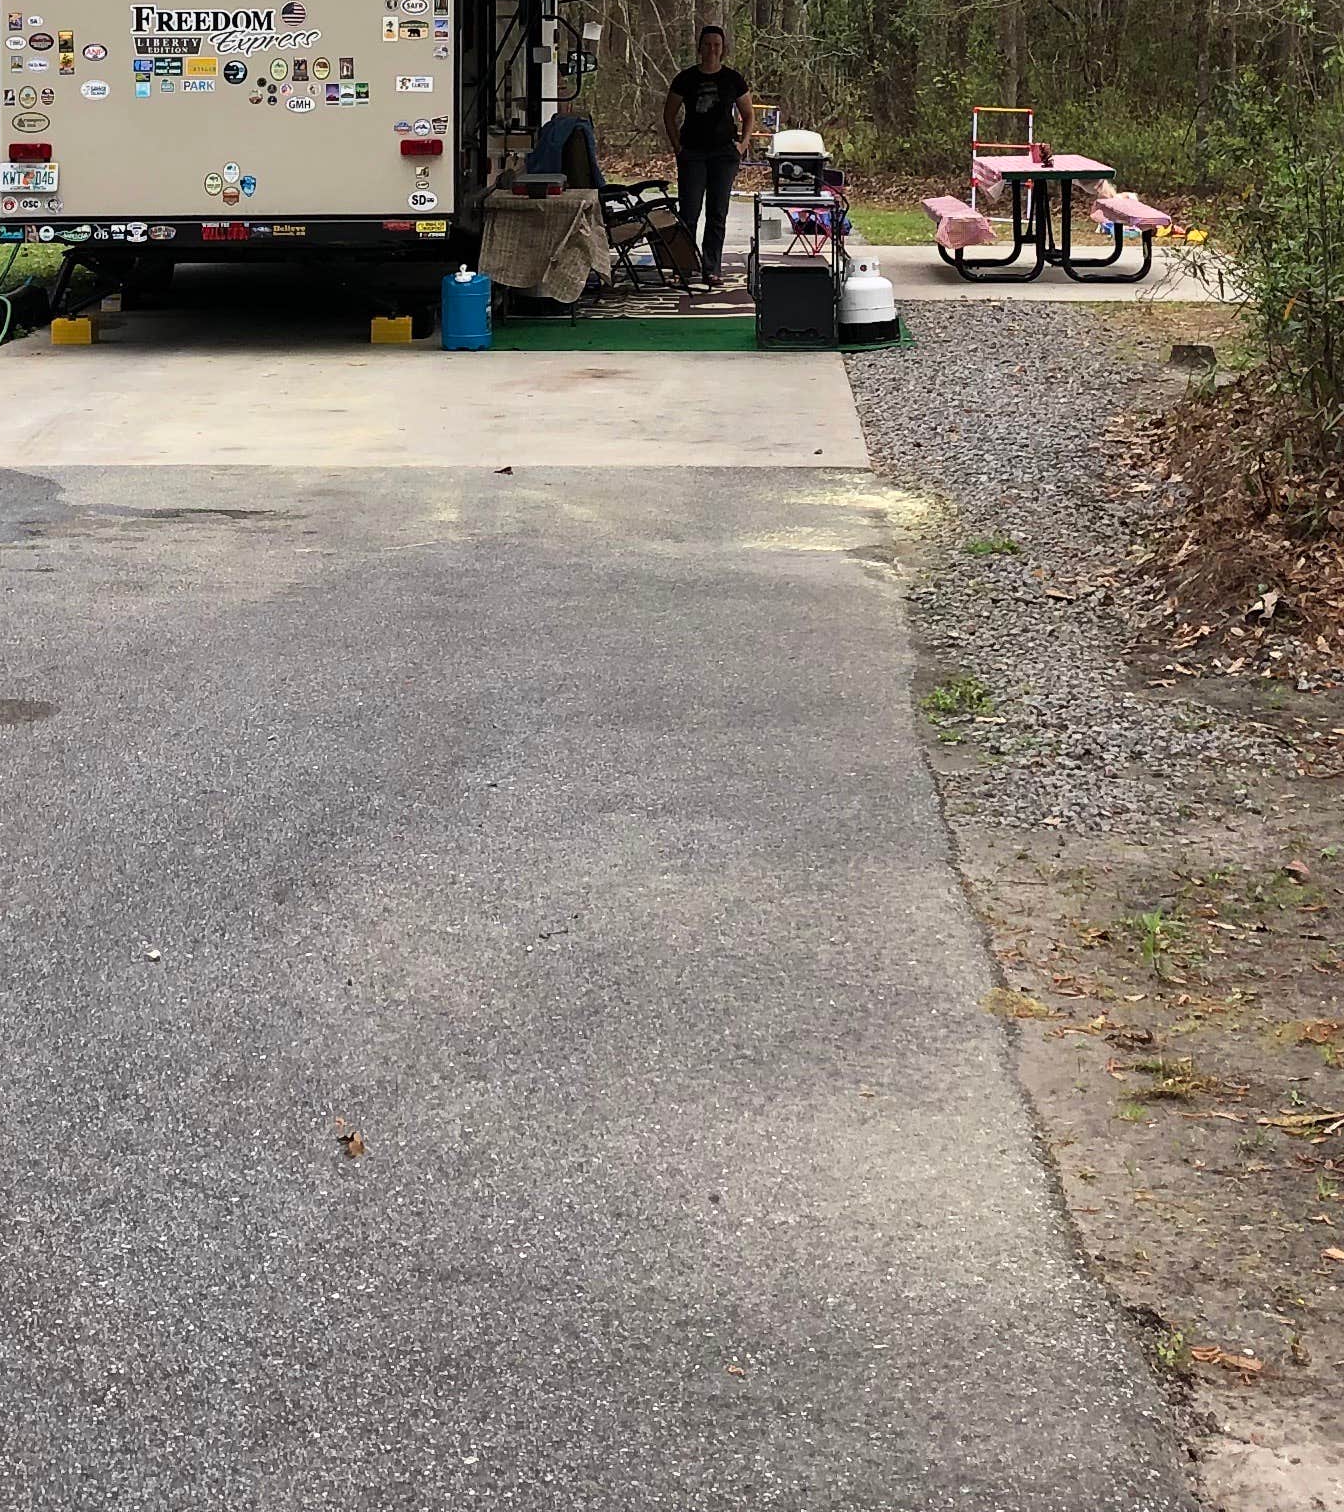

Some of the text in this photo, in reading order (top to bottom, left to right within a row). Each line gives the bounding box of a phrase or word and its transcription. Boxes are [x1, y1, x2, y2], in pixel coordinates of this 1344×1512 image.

[132, 6, 275, 33] FREEDOM
[136, 38, 200, 47] LIBERTY
[210, 29, 320, 56] Express
[183, 81, 215, 91] PARK
[288, 99, 311, 109] GMH
[2, 171, 22, 185] KWT
[411, 194, 427, 206] SD
